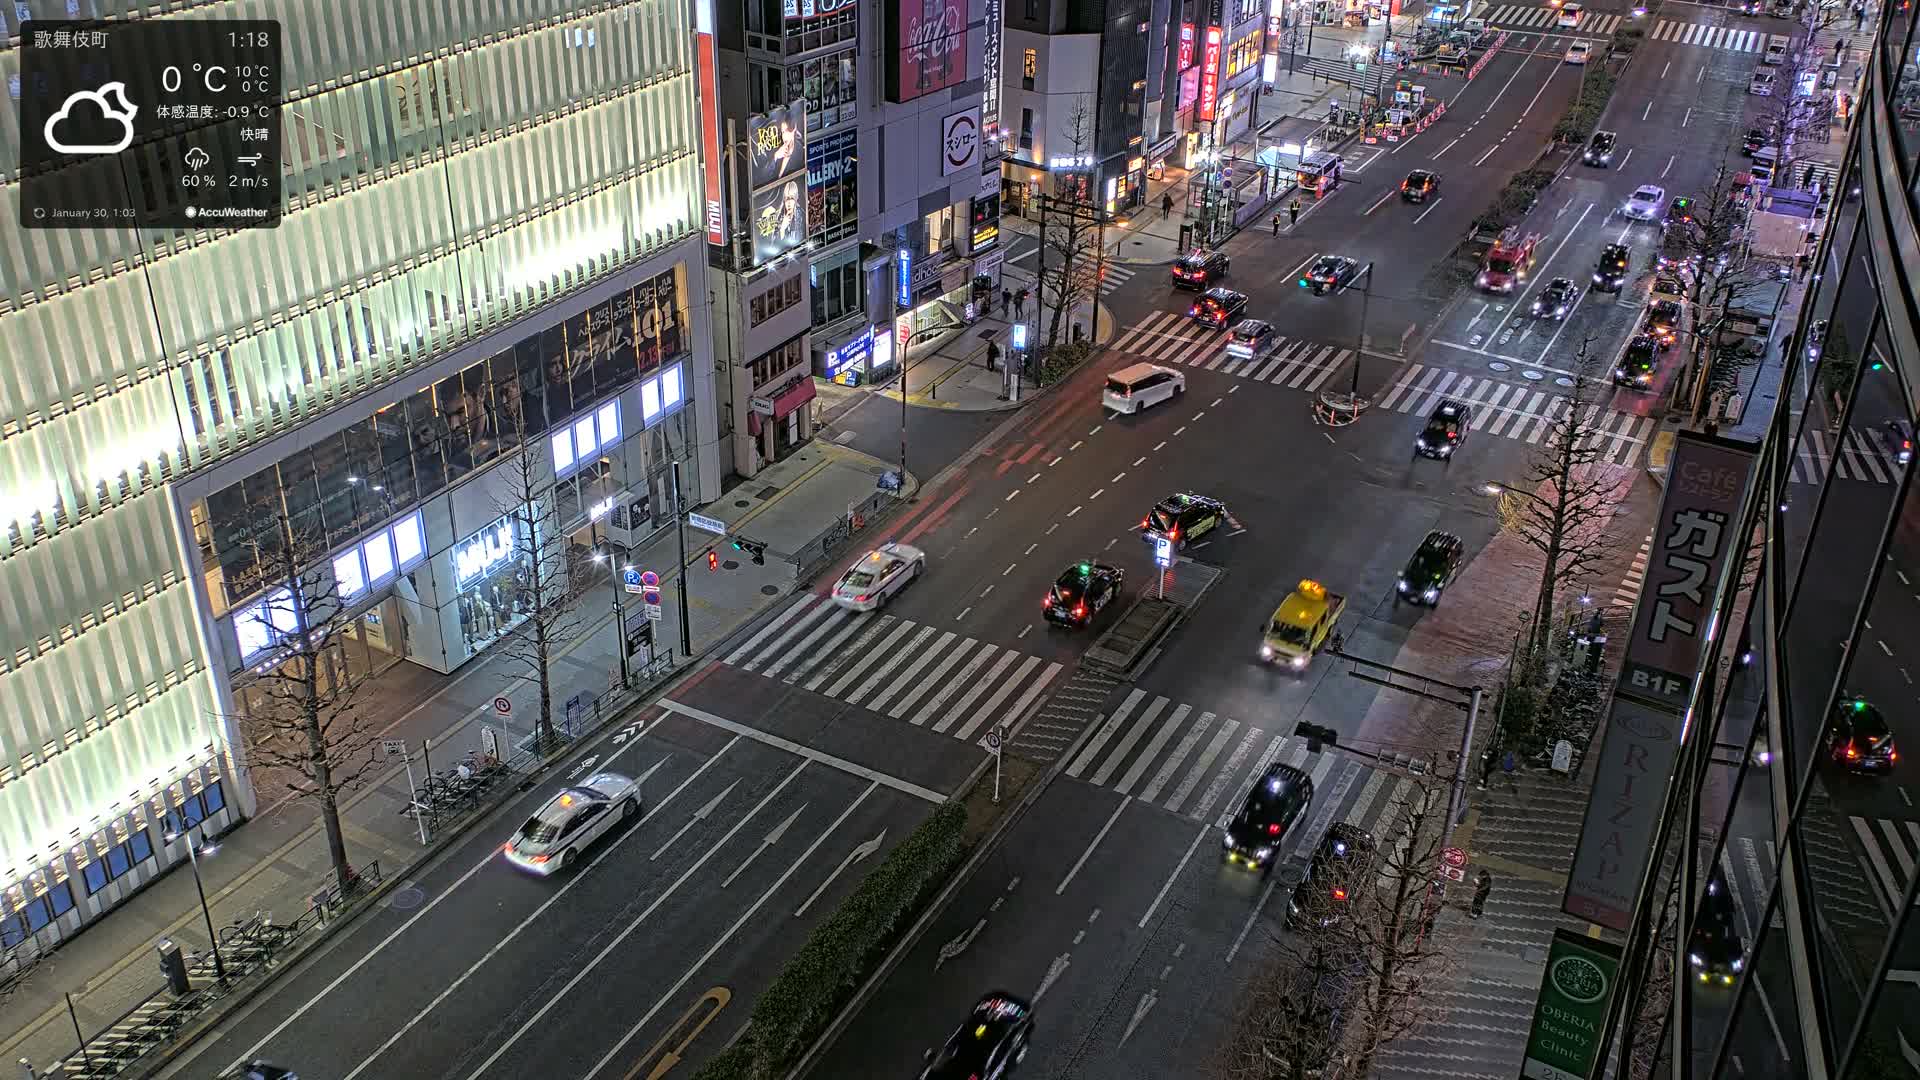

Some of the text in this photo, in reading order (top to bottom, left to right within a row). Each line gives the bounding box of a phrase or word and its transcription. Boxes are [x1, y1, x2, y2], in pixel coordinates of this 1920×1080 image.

[1204, 45, 1218, 111] バーガーキング
[946, 133, 977, 153] スシロー
[709, 200, 721, 233] MUJI
[569, 300, 675, 379] クライム 101
[457, 523, 513, 582] MUJI
[1159, 540, 1167, 549] P
[1650, 509, 1726, 642] ガスト
[1630, 669, 1682, 696] B1F
[1597, 742, 1649, 880] RIZAP
[1557, 970, 1599, 992] OBERIA
[1541, 1004, 1597, 1033] OBERIA
[1541, 1020, 1591, 1047] Beauty
[1540, 1038, 1584, 1062] Clinic
